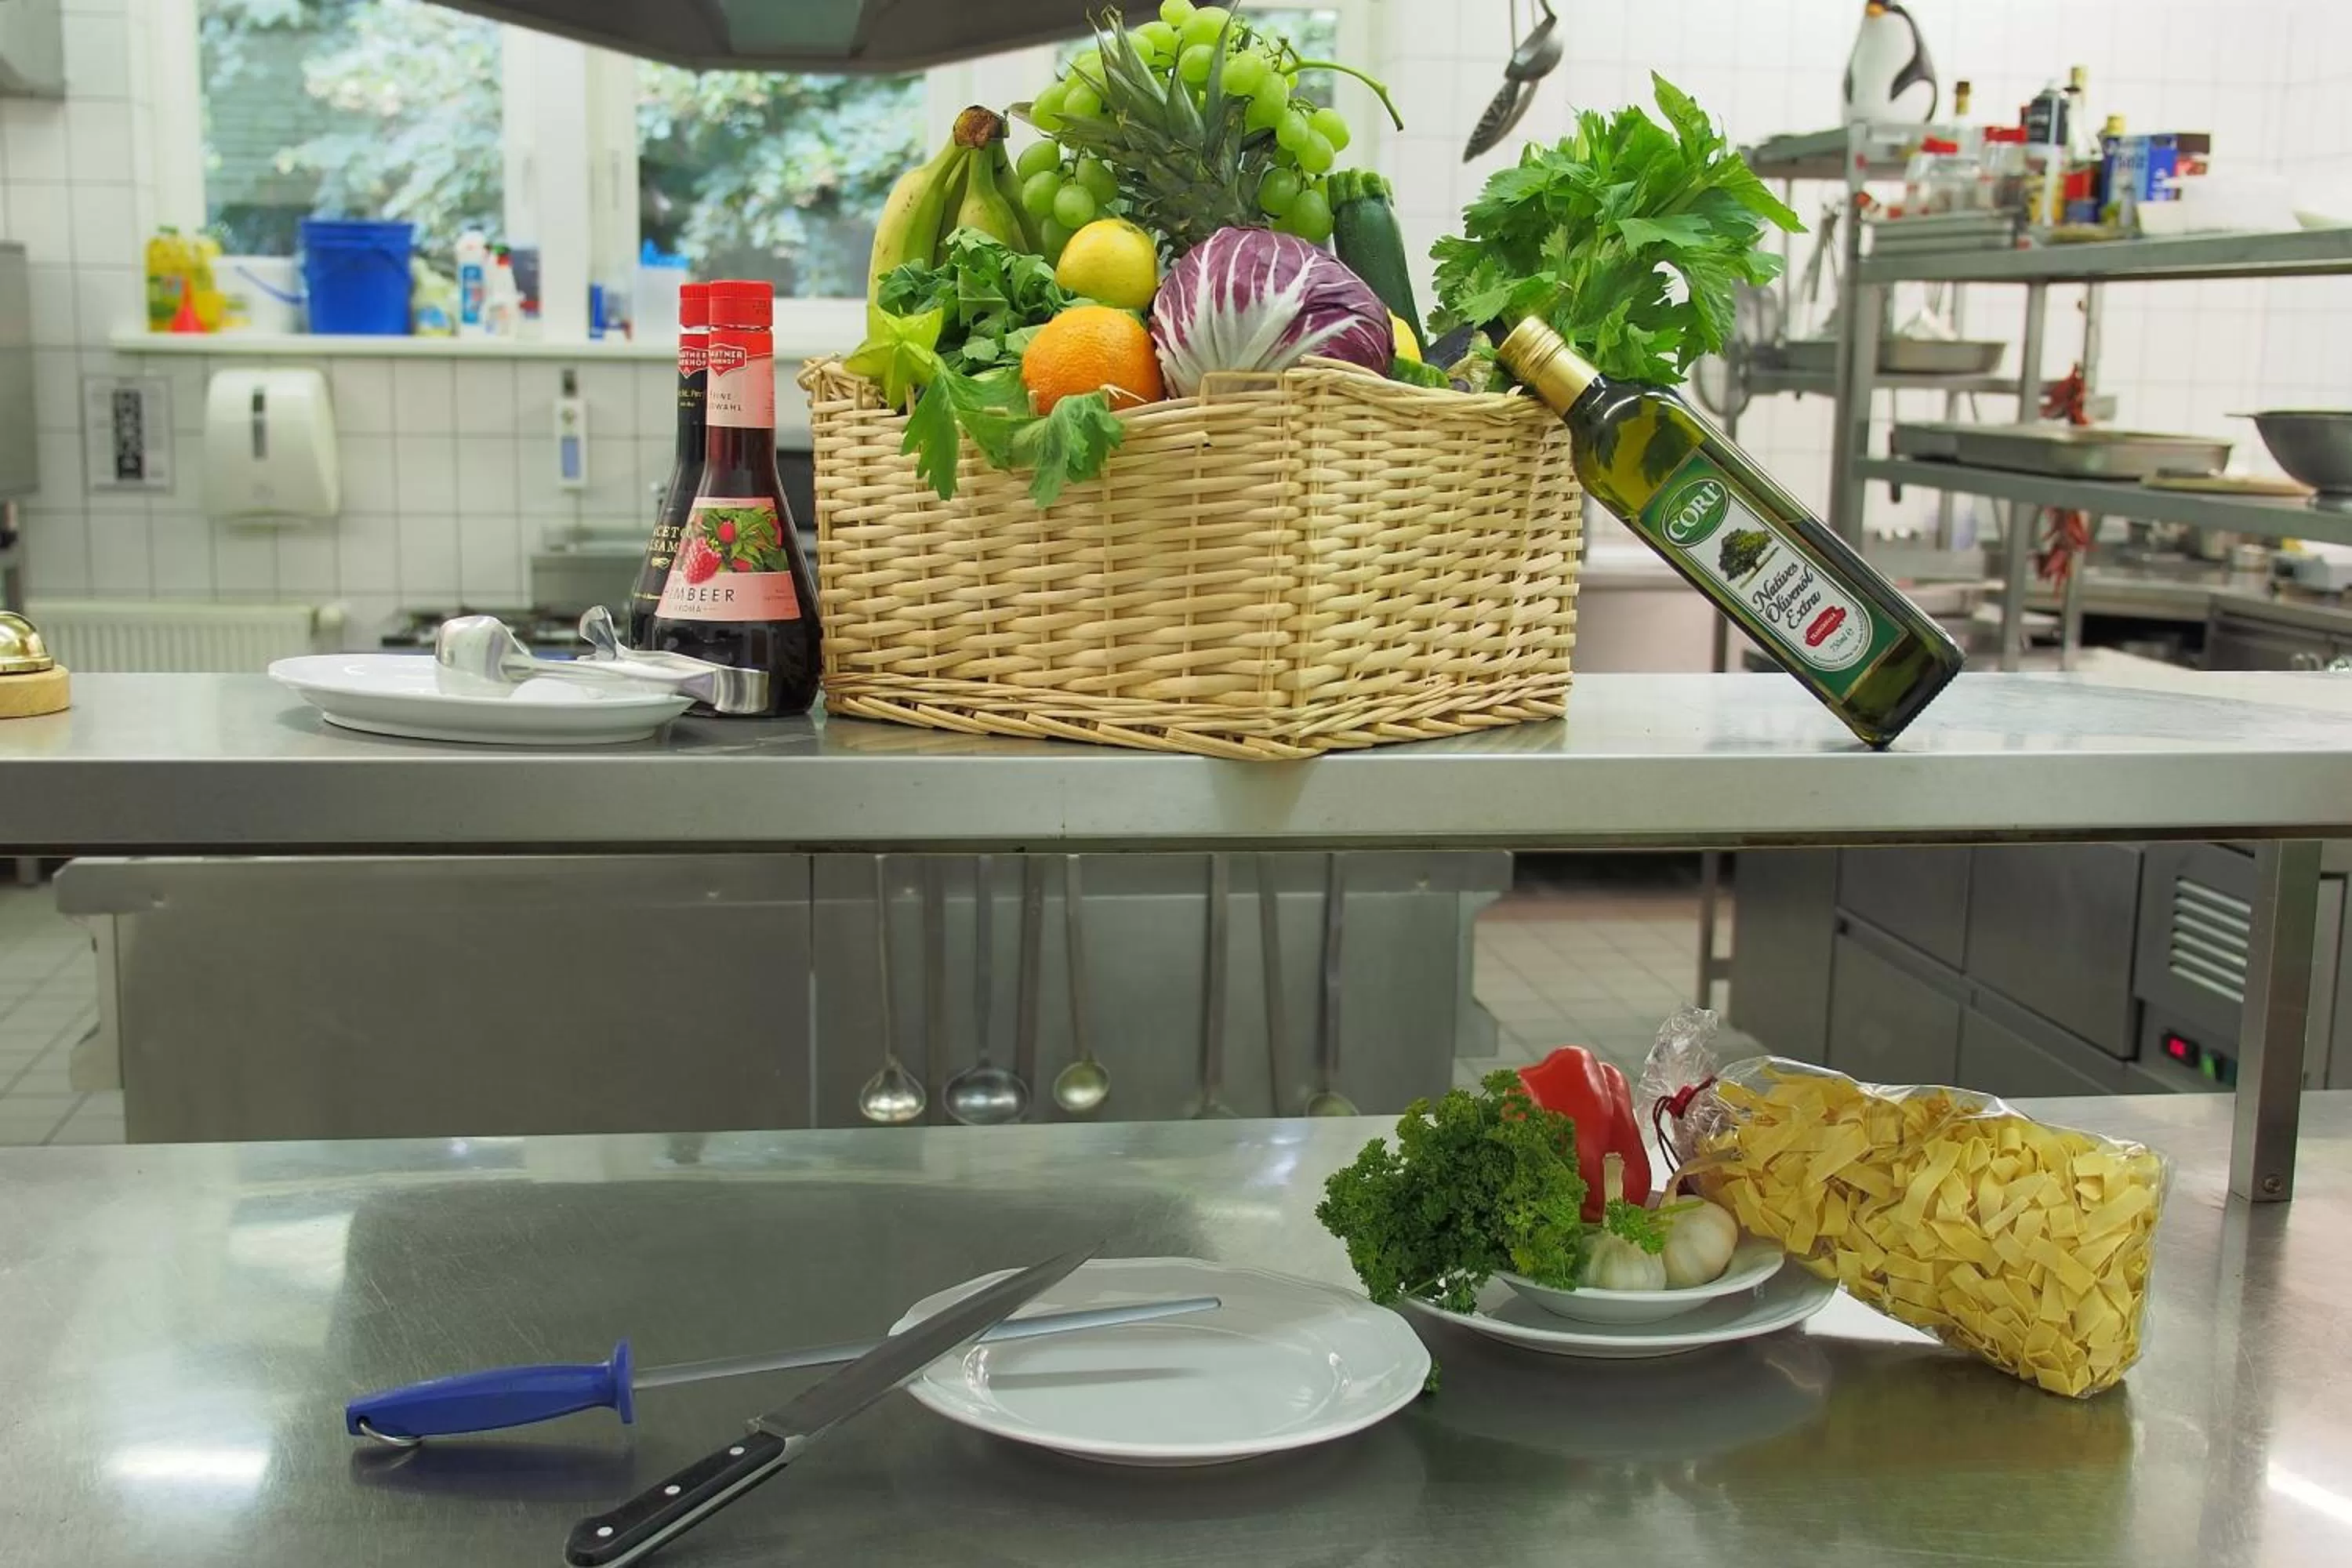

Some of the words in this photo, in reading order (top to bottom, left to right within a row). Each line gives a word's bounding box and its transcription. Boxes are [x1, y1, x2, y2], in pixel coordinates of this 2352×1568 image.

[1752, 562, 1798, 611] Natives
[1766, 564, 1813, 623] Olivenöl
[1786, 591, 1821, 629] Extra
